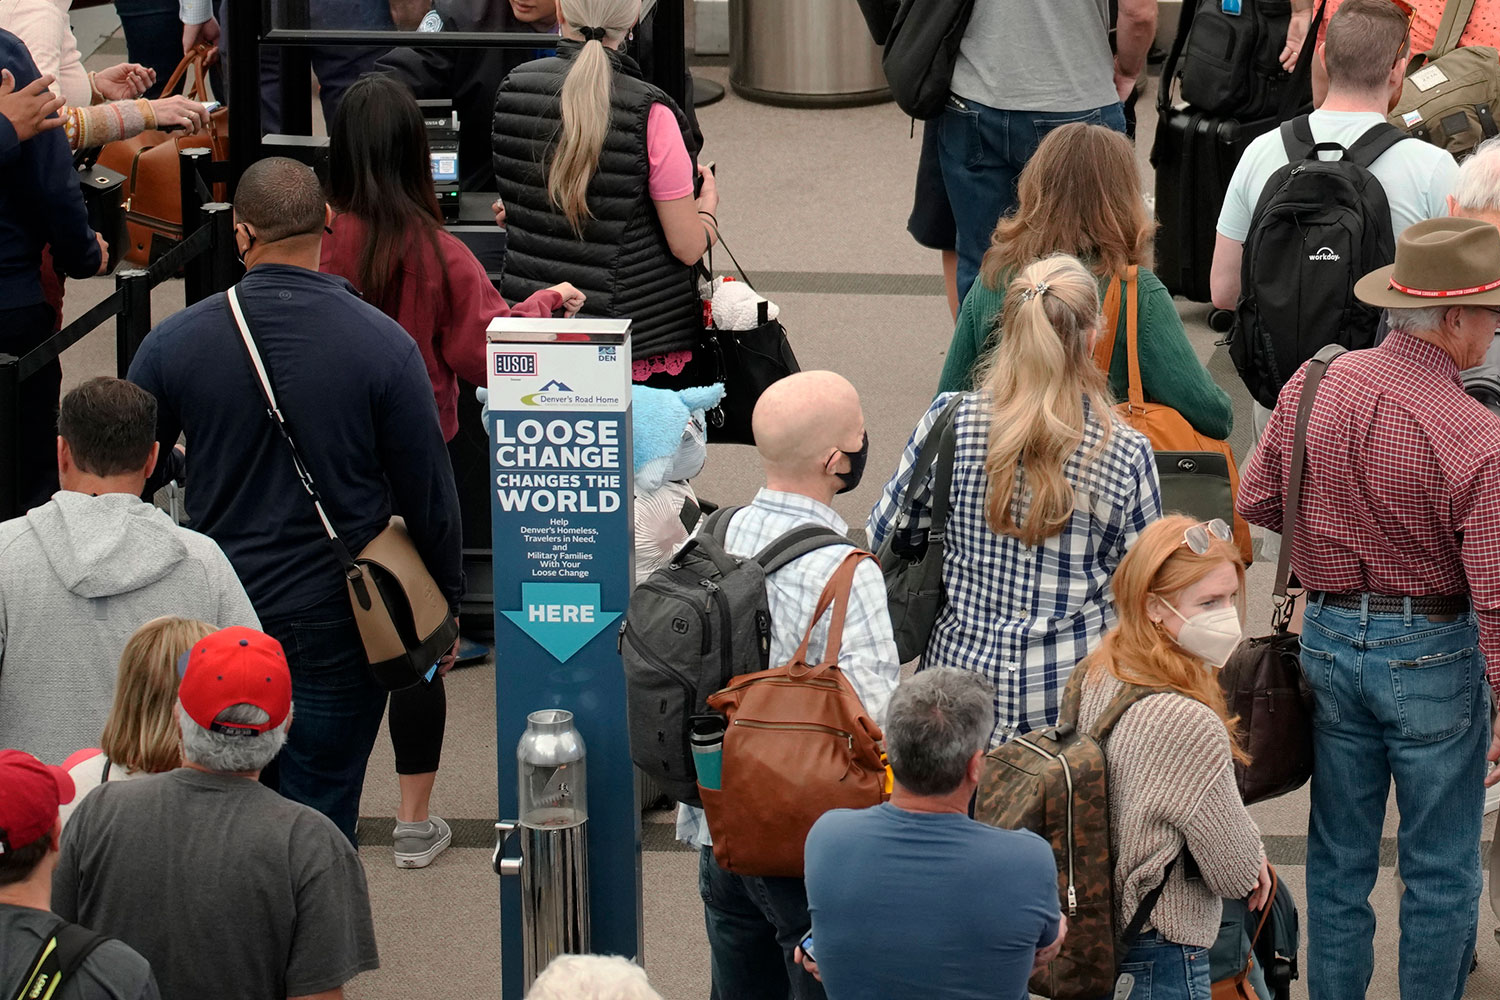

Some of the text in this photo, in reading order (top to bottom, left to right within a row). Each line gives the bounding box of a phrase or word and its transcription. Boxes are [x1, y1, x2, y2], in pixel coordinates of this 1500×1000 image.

[502, 355, 528, 373] USO
[540, 395, 619, 404] Denver's Road Home
[496, 419, 619, 446] LOOSE
[496, 445, 619, 468] CHANGE
[496, 474, 620, 488] CHANGES THE
[497, 489, 620, 513] WORLD
[550, 518, 569, 527] Help
[520, 526, 599, 535] Denver's Homeless,
[523, 535, 596, 544] Travelers in Need,
[552, 543, 568, 551] and
[527, 552, 593, 560] Military Families
[540, 560, 560, 568] With
[532, 569, 590, 578] Loose Change
[528, 604, 595, 623] HERE
